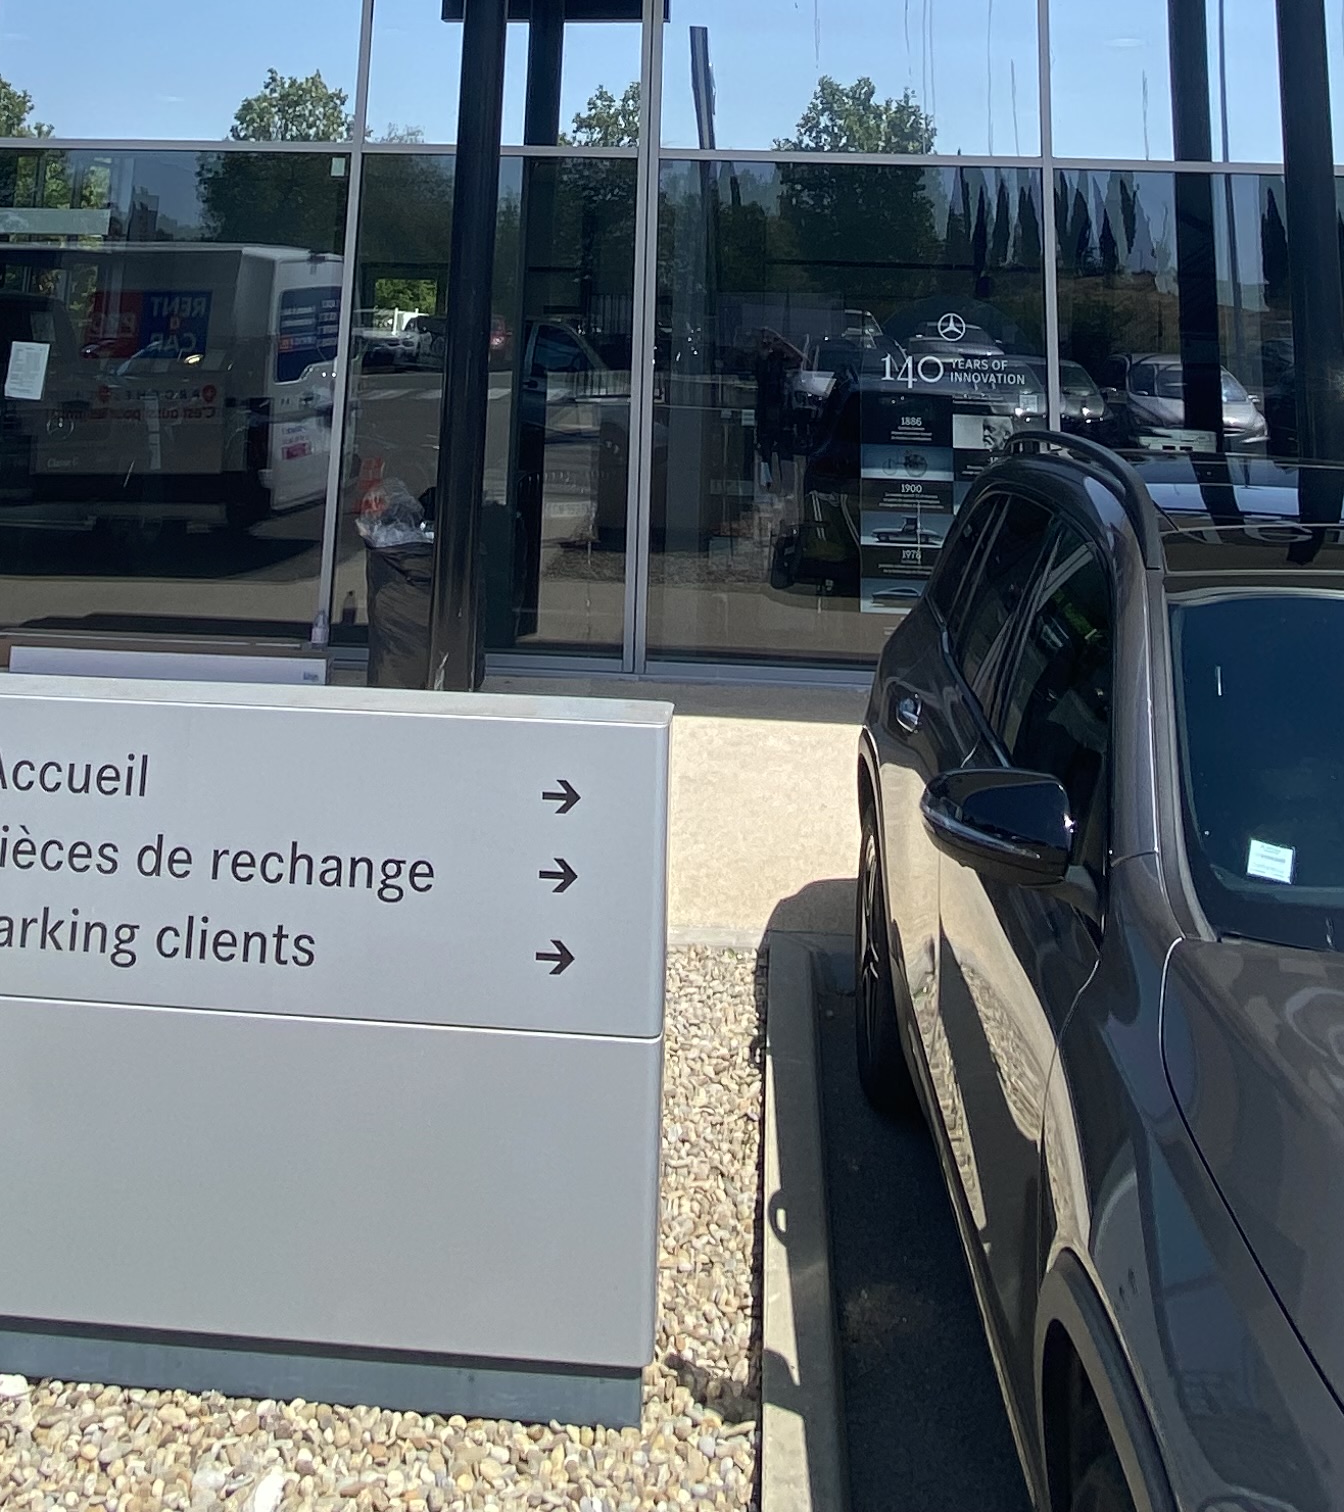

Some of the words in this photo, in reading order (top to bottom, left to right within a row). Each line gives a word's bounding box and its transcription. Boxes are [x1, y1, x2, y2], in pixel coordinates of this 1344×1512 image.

[881, 353, 944, 388] 140
[951, 358, 988, 370] YEARS
[992, 359, 1008, 371] OF
[950, 372, 1025, 385] INNOVATION
[137, 833, 193, 880] de
[211, 841, 436, 903] rechange
[156, 915, 316, 968] clients
